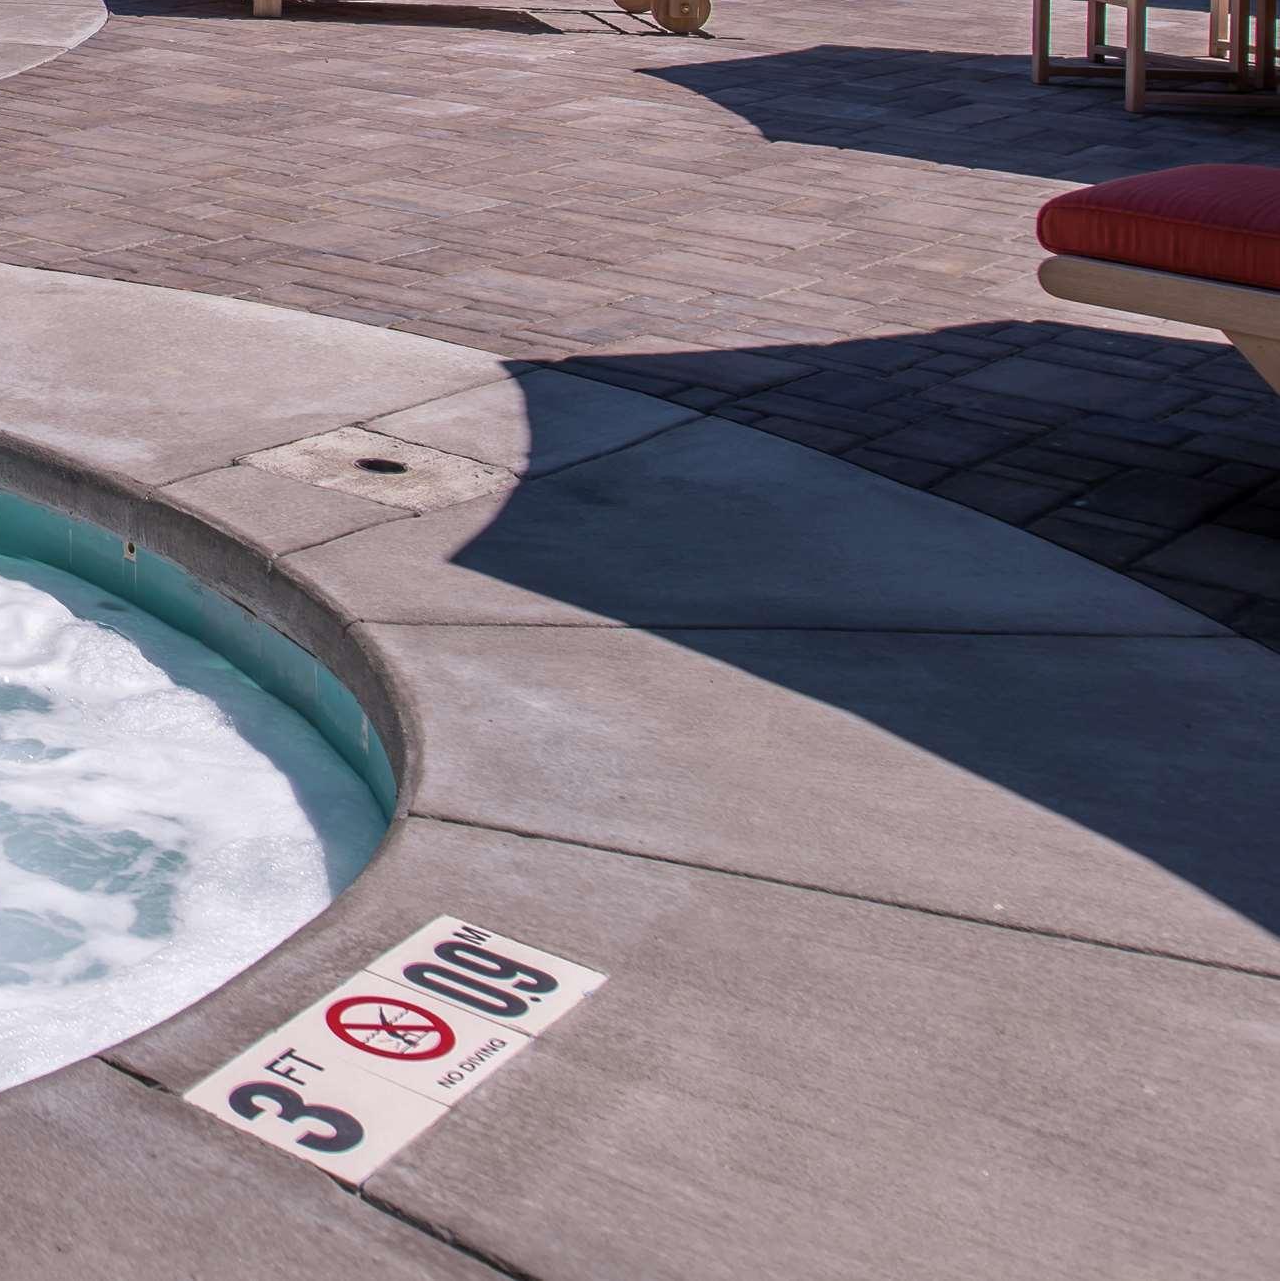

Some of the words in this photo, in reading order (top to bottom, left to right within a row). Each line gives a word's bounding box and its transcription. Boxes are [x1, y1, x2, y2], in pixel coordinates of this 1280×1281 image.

[264, 1047, 325, 1087] FT
[437, 1070, 465, 1089] NO
[458, 1038, 507, 1073] DIVING
[228, 1080, 365, 1155] 3
